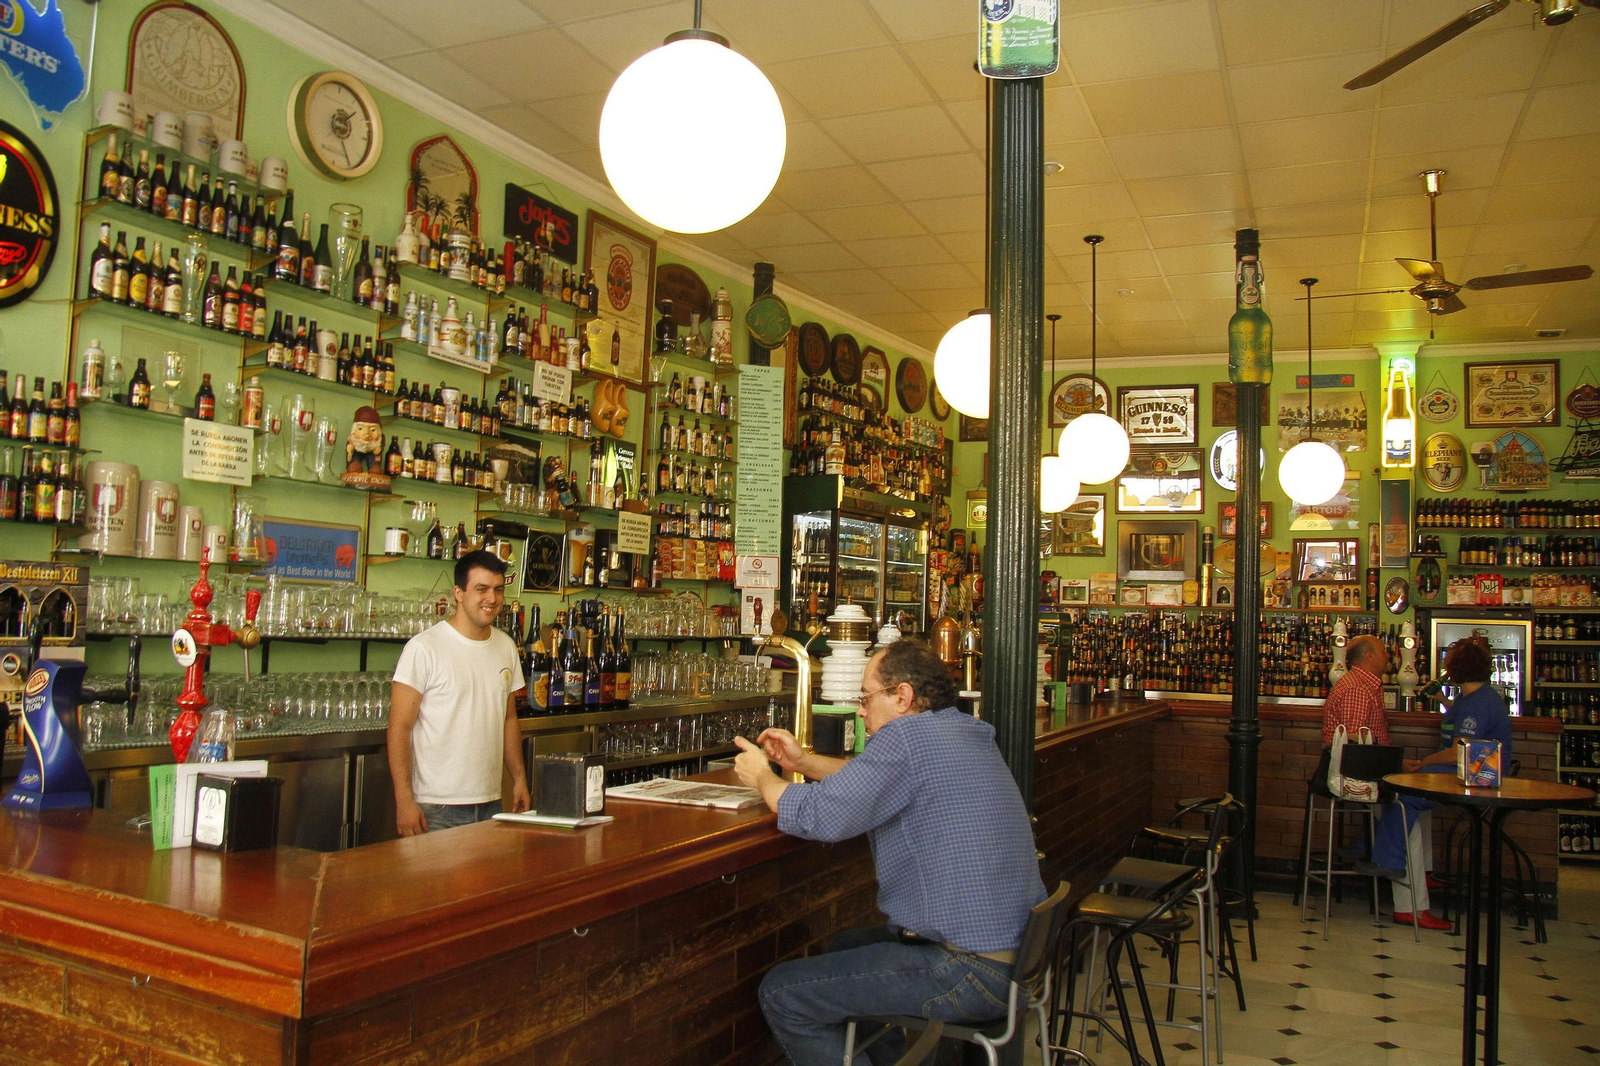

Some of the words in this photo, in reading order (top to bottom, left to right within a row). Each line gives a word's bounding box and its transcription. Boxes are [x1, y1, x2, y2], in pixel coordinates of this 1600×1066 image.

[1128, 402, 1188, 418] GUINNESS
[1141, 416, 1151, 425] 17
[1424, 449, 1462, 458] ELEPHANT
[1305, 505, 1344, 514] ARTOIS
[280, 536, 335, 553] DELIRIUM
[287, 566, 301, 576] Best
[302, 567, 317, 577] Beer
[317, 568, 323, 576] in
[324, 568, 333, 577] the
[334, 568, 351, 579] World
[1480, 580, 1499, 593] Duff
